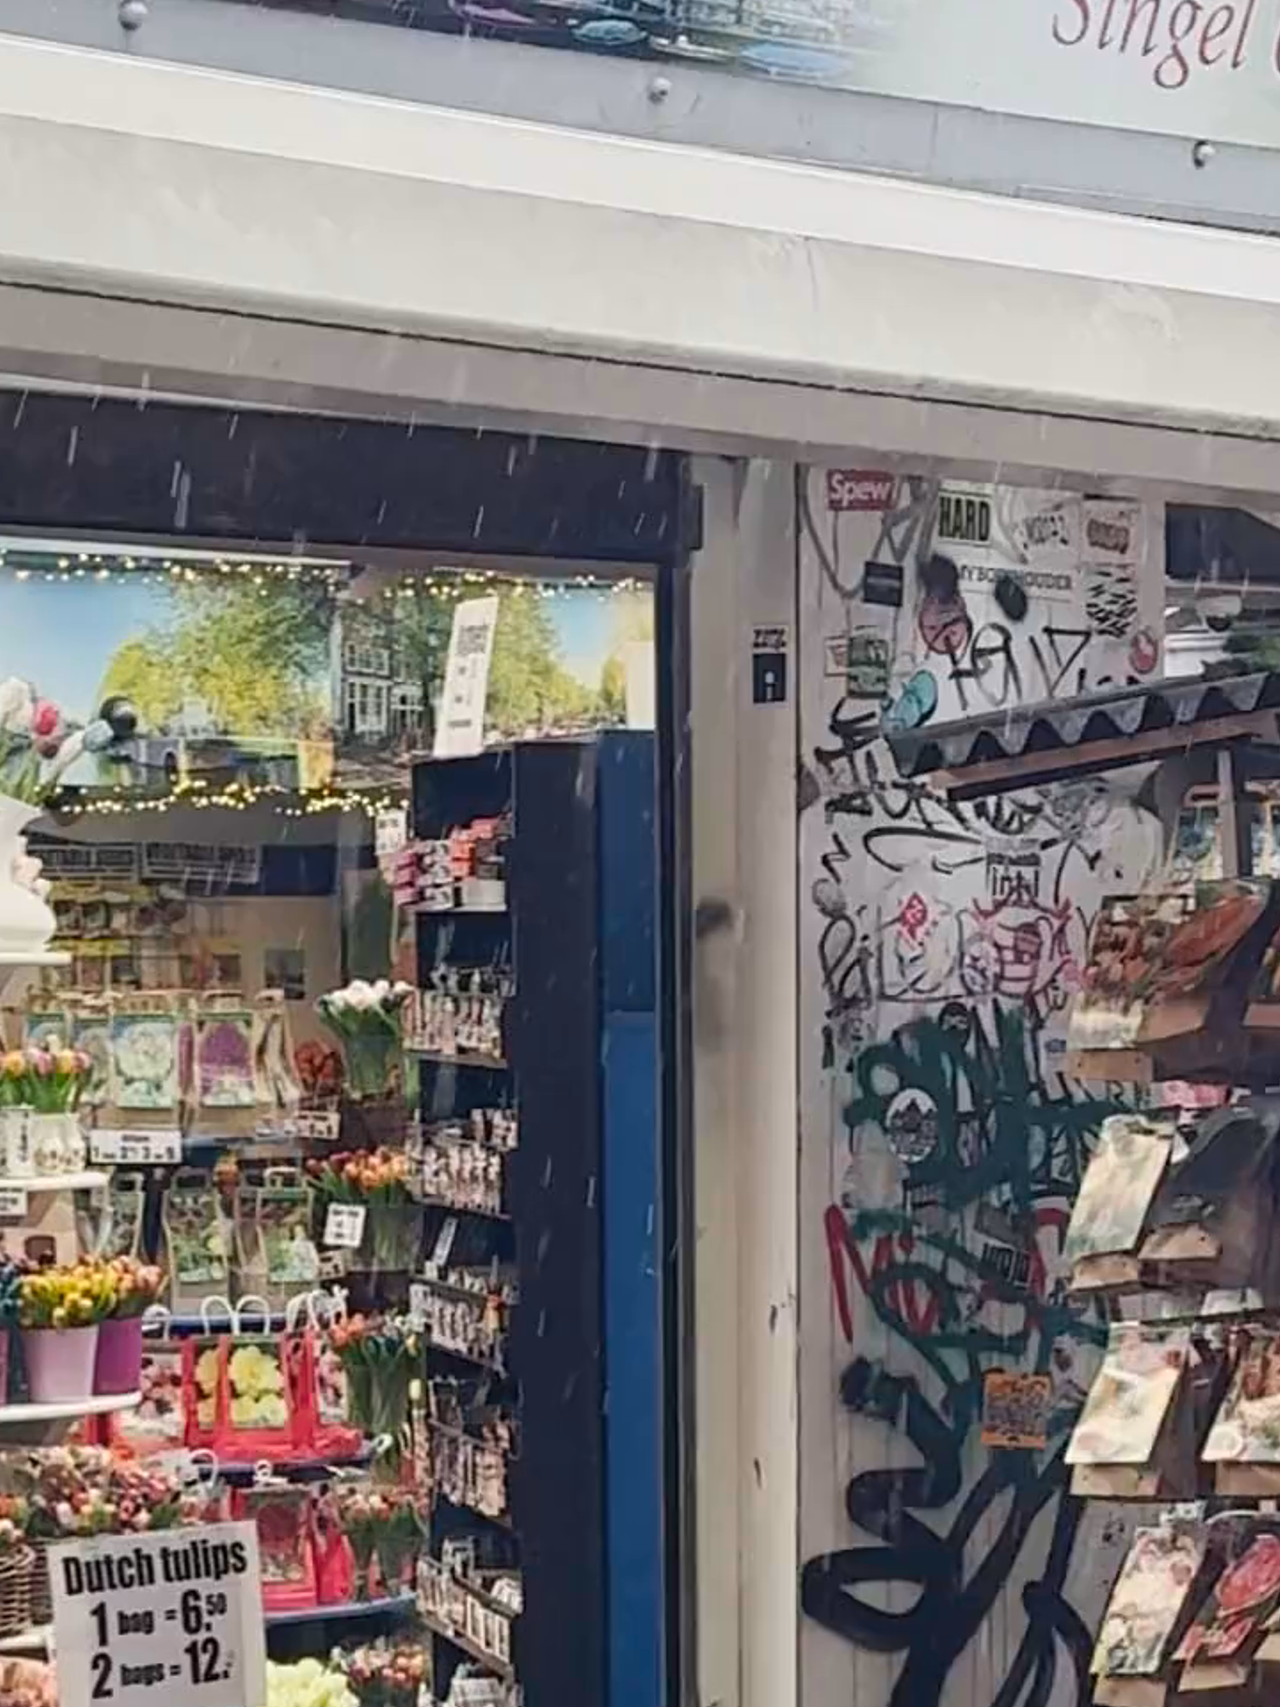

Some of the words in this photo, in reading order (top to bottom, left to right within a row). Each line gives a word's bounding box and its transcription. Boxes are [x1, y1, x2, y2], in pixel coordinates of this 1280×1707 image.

[938, 495, 991, 543] HARD
[61, 1546, 156, 1597] Dutch
[160, 1538, 248, 1583] tulips
[89, 1600, 109, 1648] 1
[116, 1609, 155, 1636] bag
[90, 1651, 115, 1700] 2
[120, 1662, 166, 1687] bags
